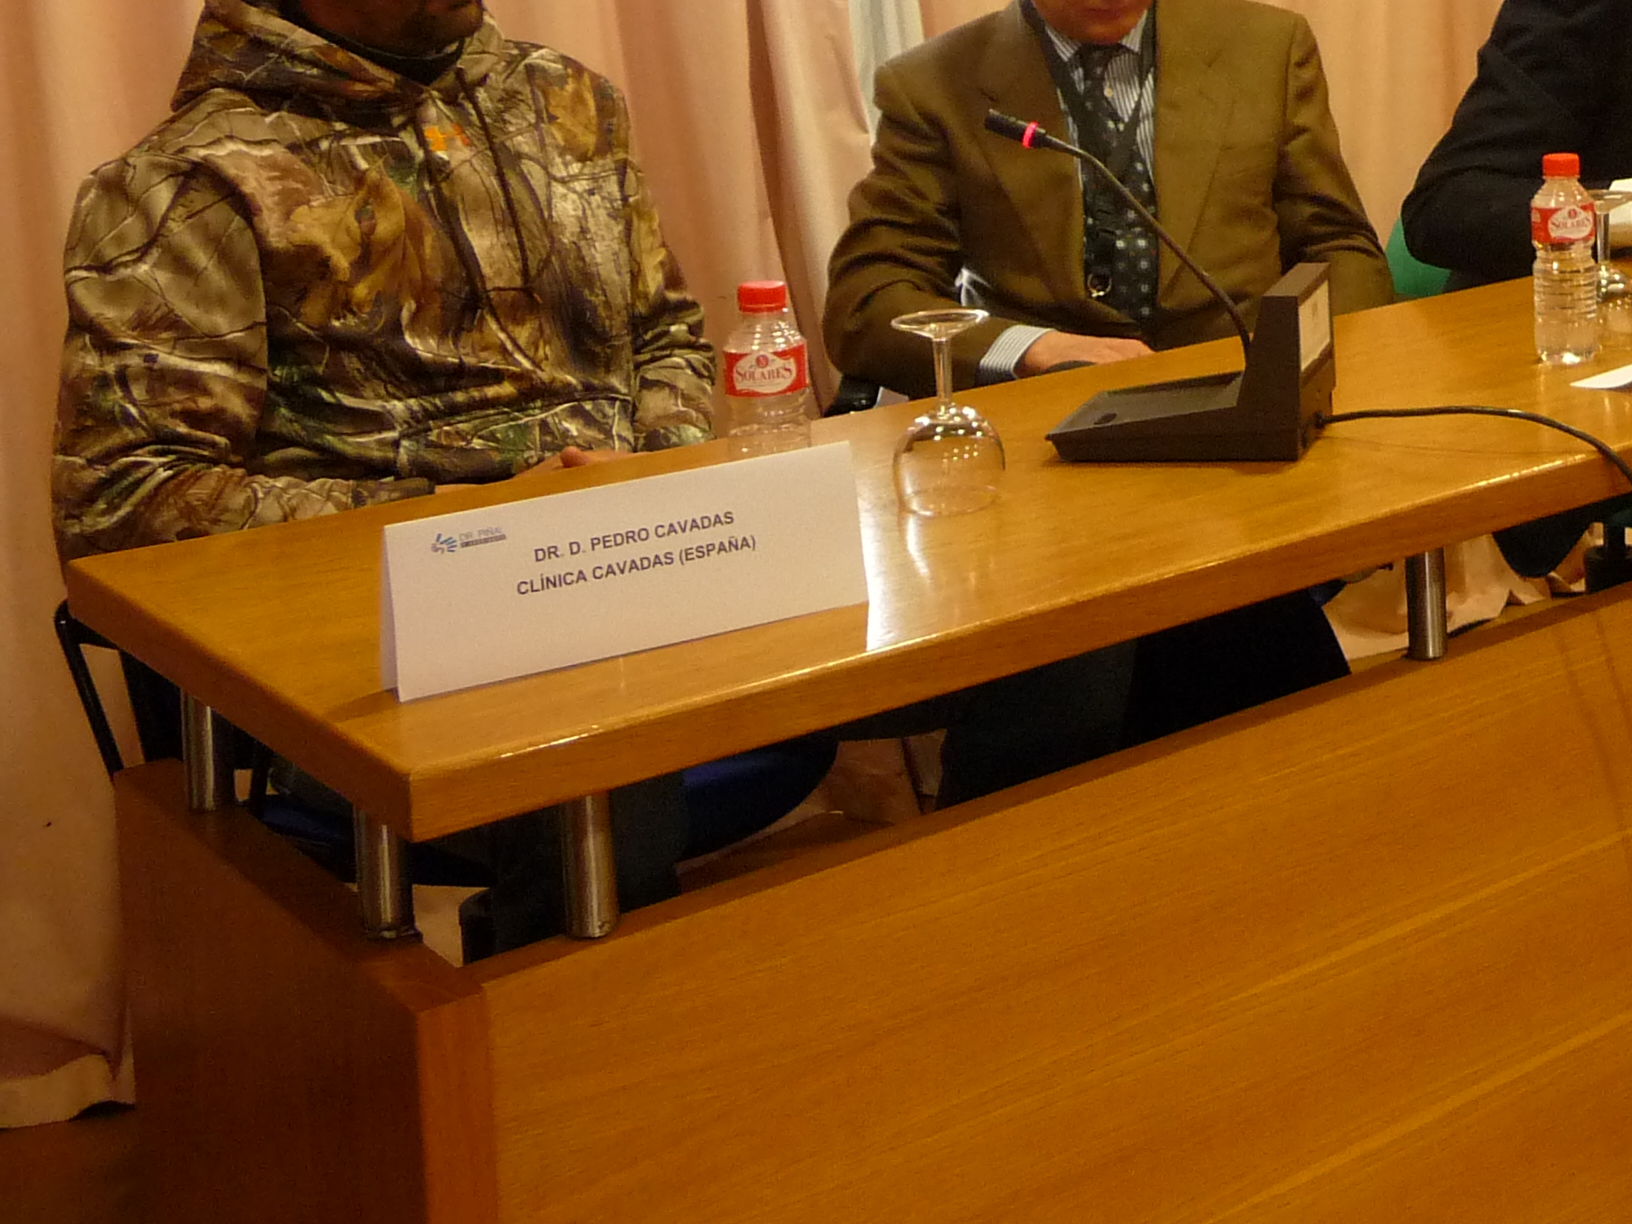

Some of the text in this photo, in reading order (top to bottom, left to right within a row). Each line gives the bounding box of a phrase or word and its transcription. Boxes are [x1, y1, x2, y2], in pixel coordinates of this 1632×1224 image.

[735, 365, 793, 382] SOLARES
[534, 511, 735, 563] DR. D. PEDRO CAVADAS
[516, 535, 757, 596] CLÍNICA CAVADAS (ESPAÑA)
